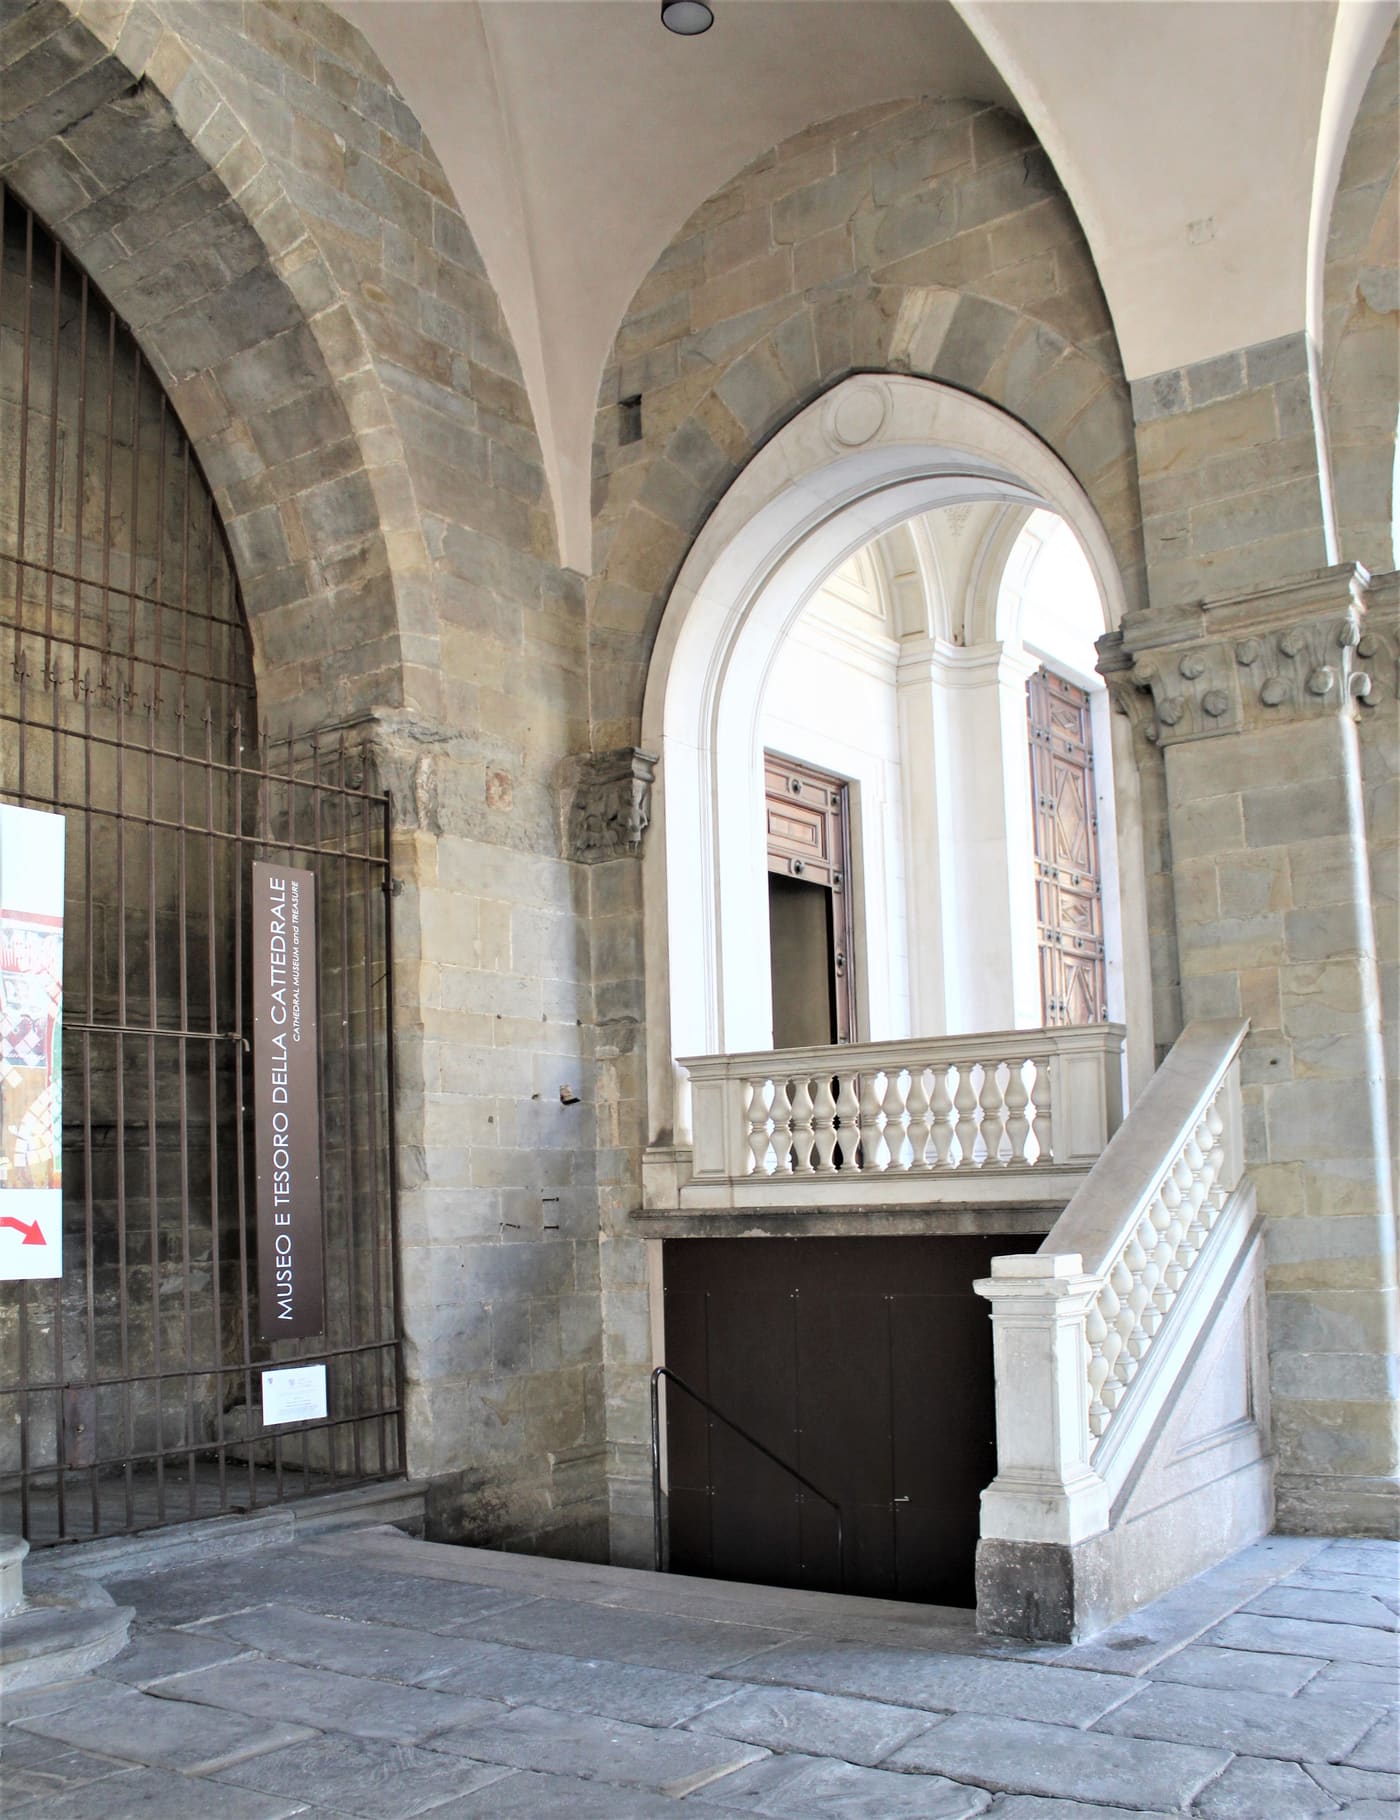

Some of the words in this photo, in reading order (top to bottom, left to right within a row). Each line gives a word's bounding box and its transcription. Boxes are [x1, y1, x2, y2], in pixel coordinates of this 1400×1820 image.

[291, 880, 299, 924] TREASURE
[269, 877, 288, 1025] CATTEDRALE
[292, 948, 301, 986] MUSEUM
[293, 987, 301, 1042] CATHEDRAL
[271, 1031, 288, 1104] DELLA
[272, 1111, 290, 1207] TESORO
[274, 1213, 291, 1226] E
[275, 1234, 293, 1320] MUSEO
